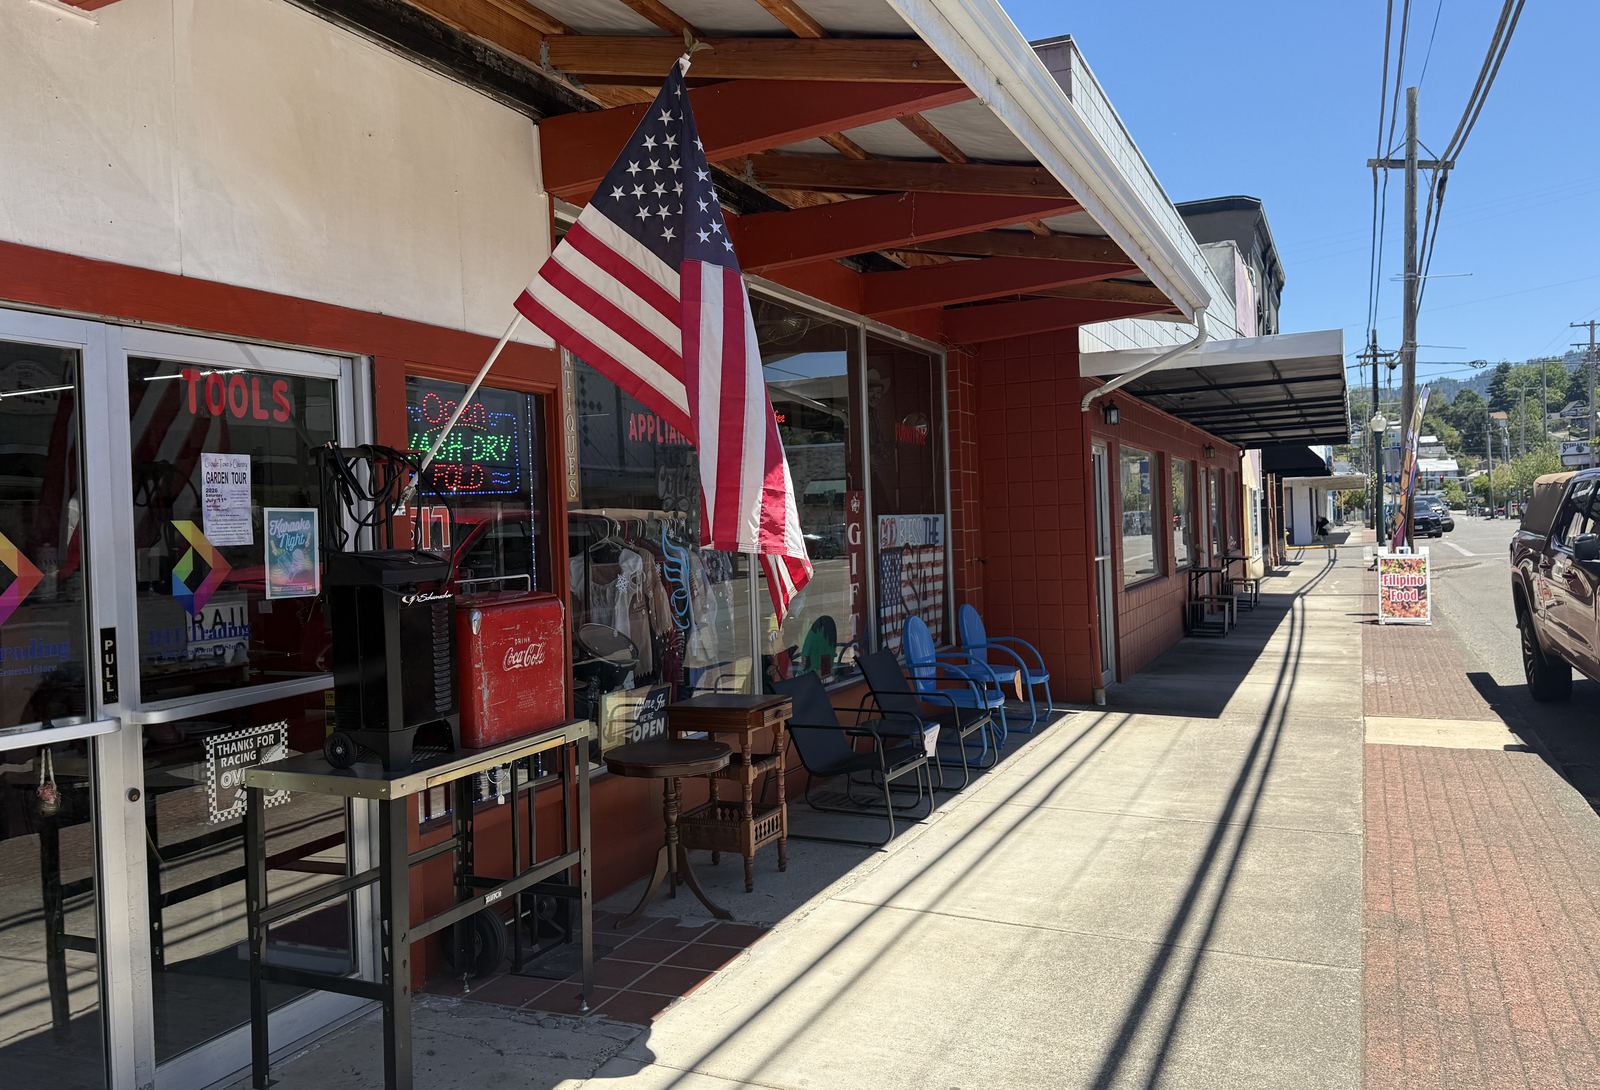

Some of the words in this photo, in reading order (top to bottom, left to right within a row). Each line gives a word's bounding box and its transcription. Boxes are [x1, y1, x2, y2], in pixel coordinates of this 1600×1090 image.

[180, 367, 291, 423] TOOLS
[563, 346, 577, 498] NTIQUES
[628, 412, 693, 446] APPLIAN
[205, 471, 229, 485] GARDEN
[231, 471, 247, 485] TOUR
[432, 462, 484, 489] FOLD
[269, 518, 311, 537] Karaoke
[923, 516, 940, 545] THE
[279, 532, 305, 551] Night
[1383, 574, 1425, 587] Filipino
[1391, 589, 1417, 601] Food
[104, 639, 114, 693] PULL
[632, 717, 665, 743] OPEN
[216, 738, 254, 757] THANKS
[256, 733, 275, 748] FOR
[220, 750, 257, 768] RACING
